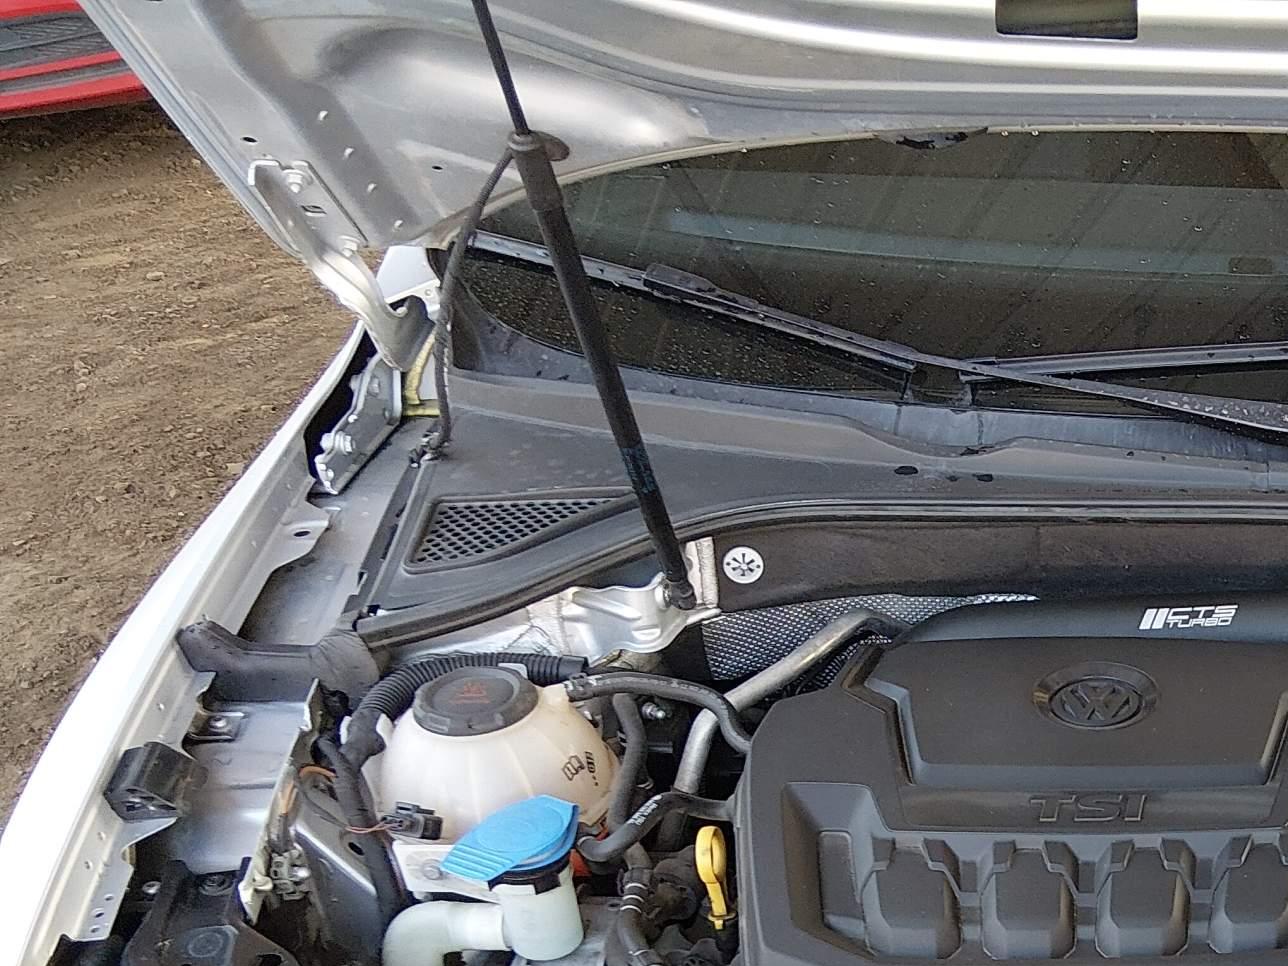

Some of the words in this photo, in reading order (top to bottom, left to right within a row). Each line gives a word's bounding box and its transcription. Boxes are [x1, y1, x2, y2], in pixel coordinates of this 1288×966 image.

[1167, 604, 1239, 620] CTS
[1166, 617, 1232, 628] TURBO
[1029, 794, 1147, 823] TSI
